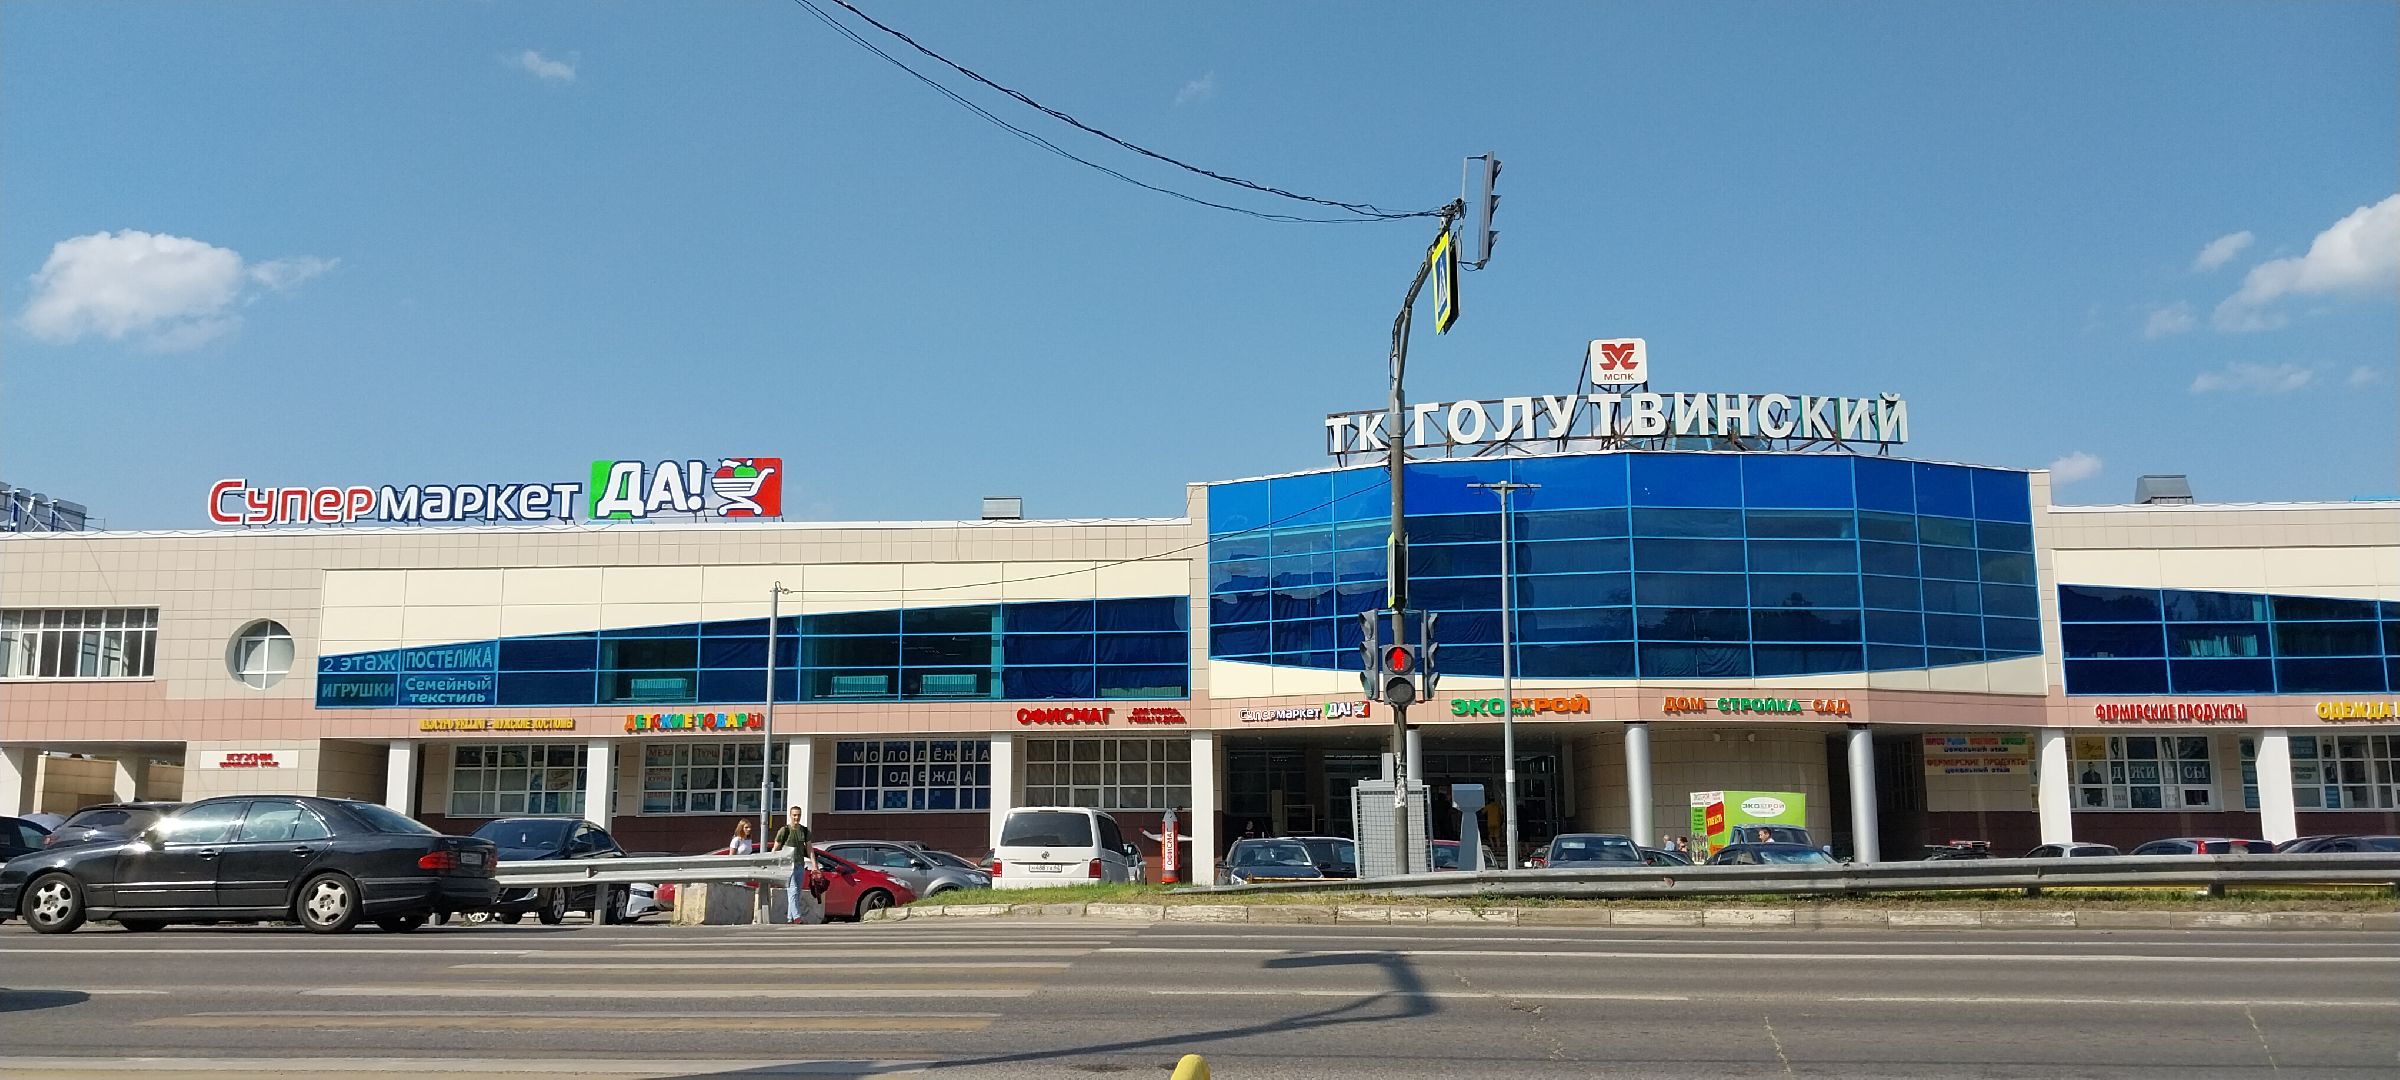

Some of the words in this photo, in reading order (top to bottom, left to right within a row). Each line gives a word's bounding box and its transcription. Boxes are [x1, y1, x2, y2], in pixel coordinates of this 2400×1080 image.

[1604, 373, 1634, 381] МСПК
[1325, 415, 1386, 453] ТК
[1413, 391, 1908, 445] ГОЛУТВИНСКИЙ
[207, 478, 582, 525] Супермаркет
[596, 460, 703, 518] ДА!
[323, 658, 334, 672] 2
[406, 647, 493, 668] ПОСТЕЛИКА
[321, 683, 395, 698] ИГРУШКИ
[405, 675, 492, 691] Семейный
[410, 692, 486, 703] текстиль
[1663, 697, 1705, 711] ДОМ
[1717, 697, 1801, 712] СТРОЙКА
[1812, 698, 1850, 714] САД
[1017, 707, 1113, 724] ОФИСМАГ
[1240, 707, 1321, 720] Супермаркет
[1328, 702, 1352, 718] ДА!
[2094, 703, 2175, 720] ФЕРМЕРСКИЕ
[2177, 703, 2246, 721] ПРОДУКТЫ
[2315, 701, 2391, 720] ОДЕЖДА
[624, 713, 693, 731] ДЕТСКИЕ
[696, 712, 763, 729] ТОВАРЫ
[889, 771, 974, 785] ОДЕЖДА
[2111, 766, 2206, 781] ДЖИНСЫ
